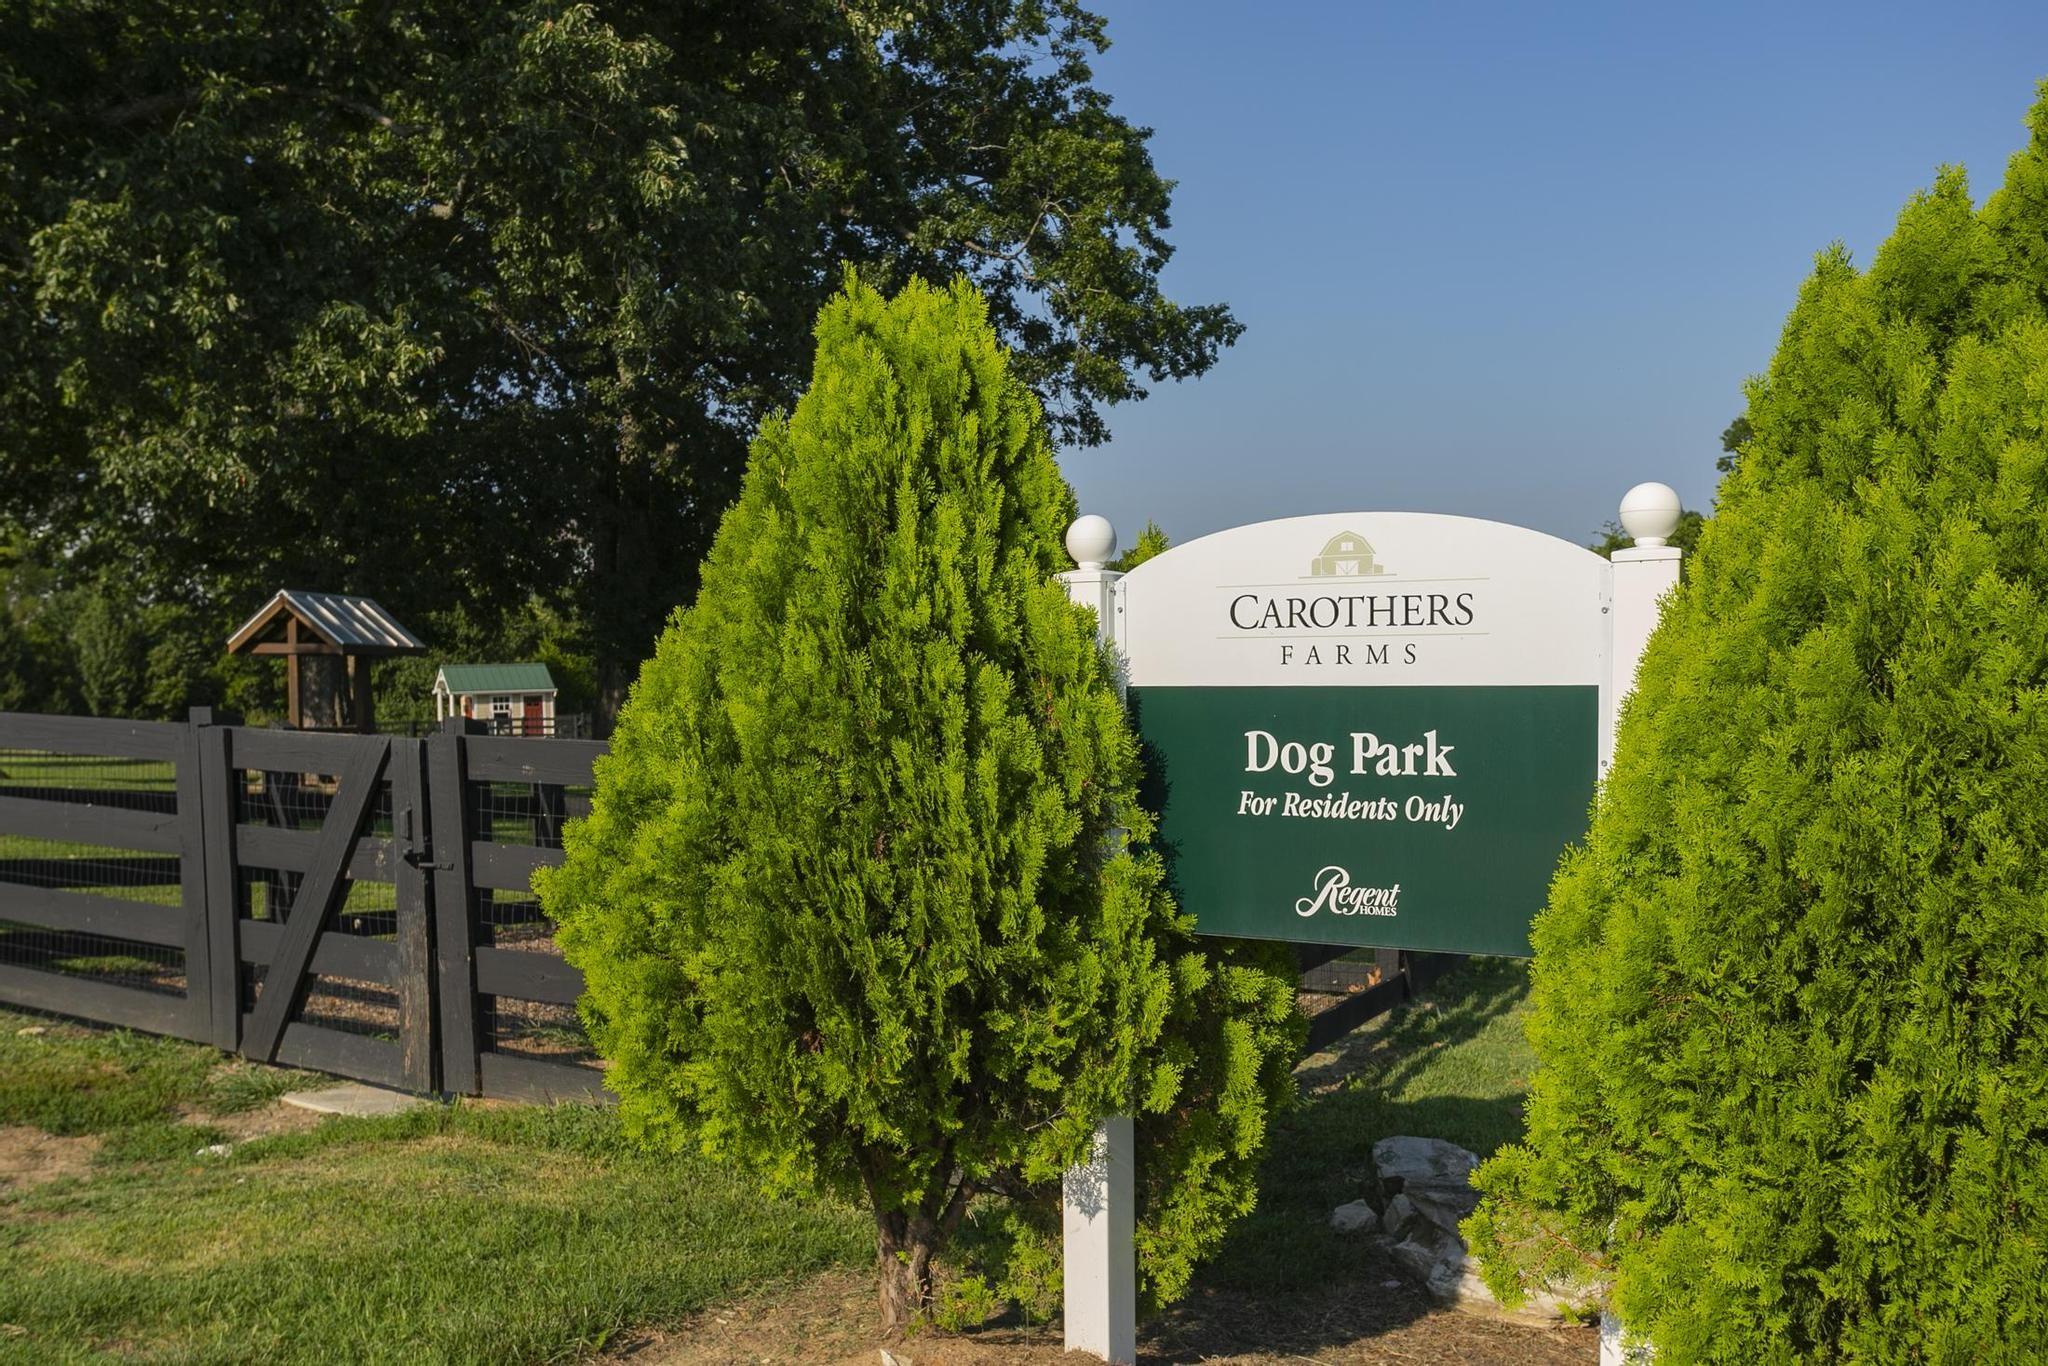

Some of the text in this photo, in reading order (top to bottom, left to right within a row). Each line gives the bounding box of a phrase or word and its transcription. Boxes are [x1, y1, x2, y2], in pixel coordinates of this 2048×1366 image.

[1229, 593, 1474, 630] CAROTHERS
[1280, 643, 1417, 665] FARMS
[1244, 730, 1458, 787] Dog Park
[1238, 791, 1464, 831] For Residents Only
[1295, 865, 1401, 917] Regent
[1359, 905, 1397, 918] HOMES
